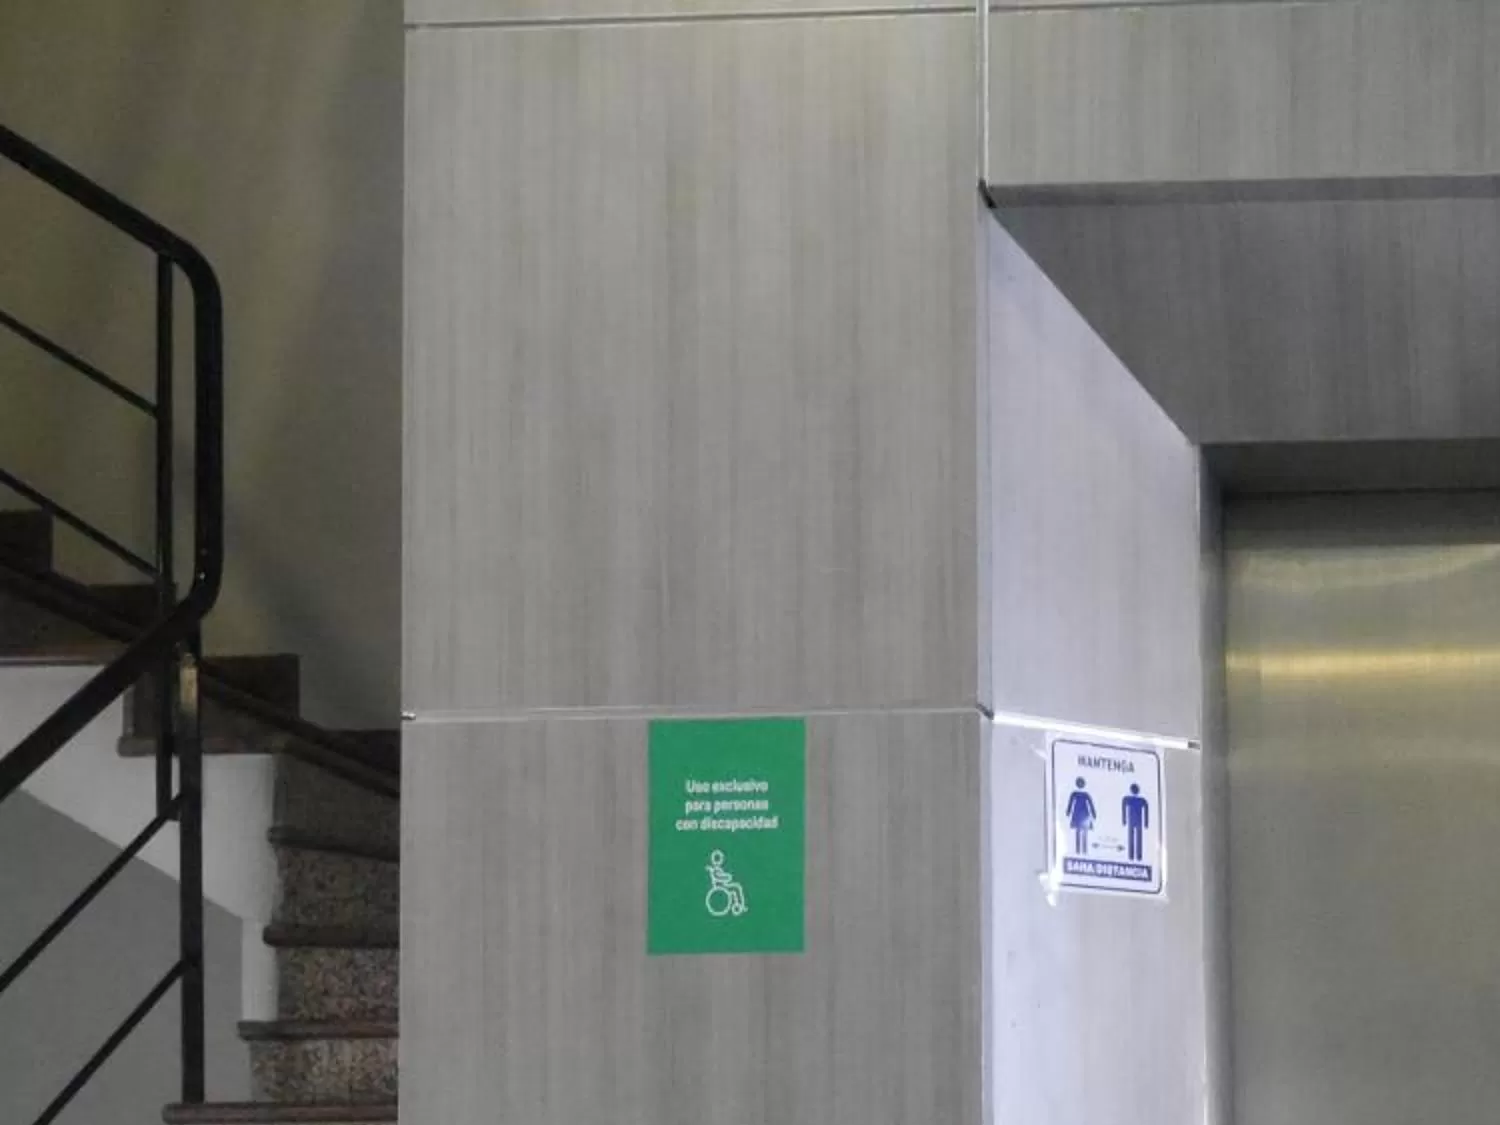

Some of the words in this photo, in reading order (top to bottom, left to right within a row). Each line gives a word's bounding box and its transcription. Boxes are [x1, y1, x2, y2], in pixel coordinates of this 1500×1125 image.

[1077, 755, 1136, 773] MANTENGA
[685, 779, 710, 793] Uso
[711, 778, 769, 793] exclusivo
[685, 800, 712, 815] para
[713, 800, 769, 814] personas
[675, 819, 699, 831] con
[700, 815, 779, 832] discapacidad
[1067, 859, 1094, 874] SANA
[1095, 862, 1149, 879] DISTANCIA
